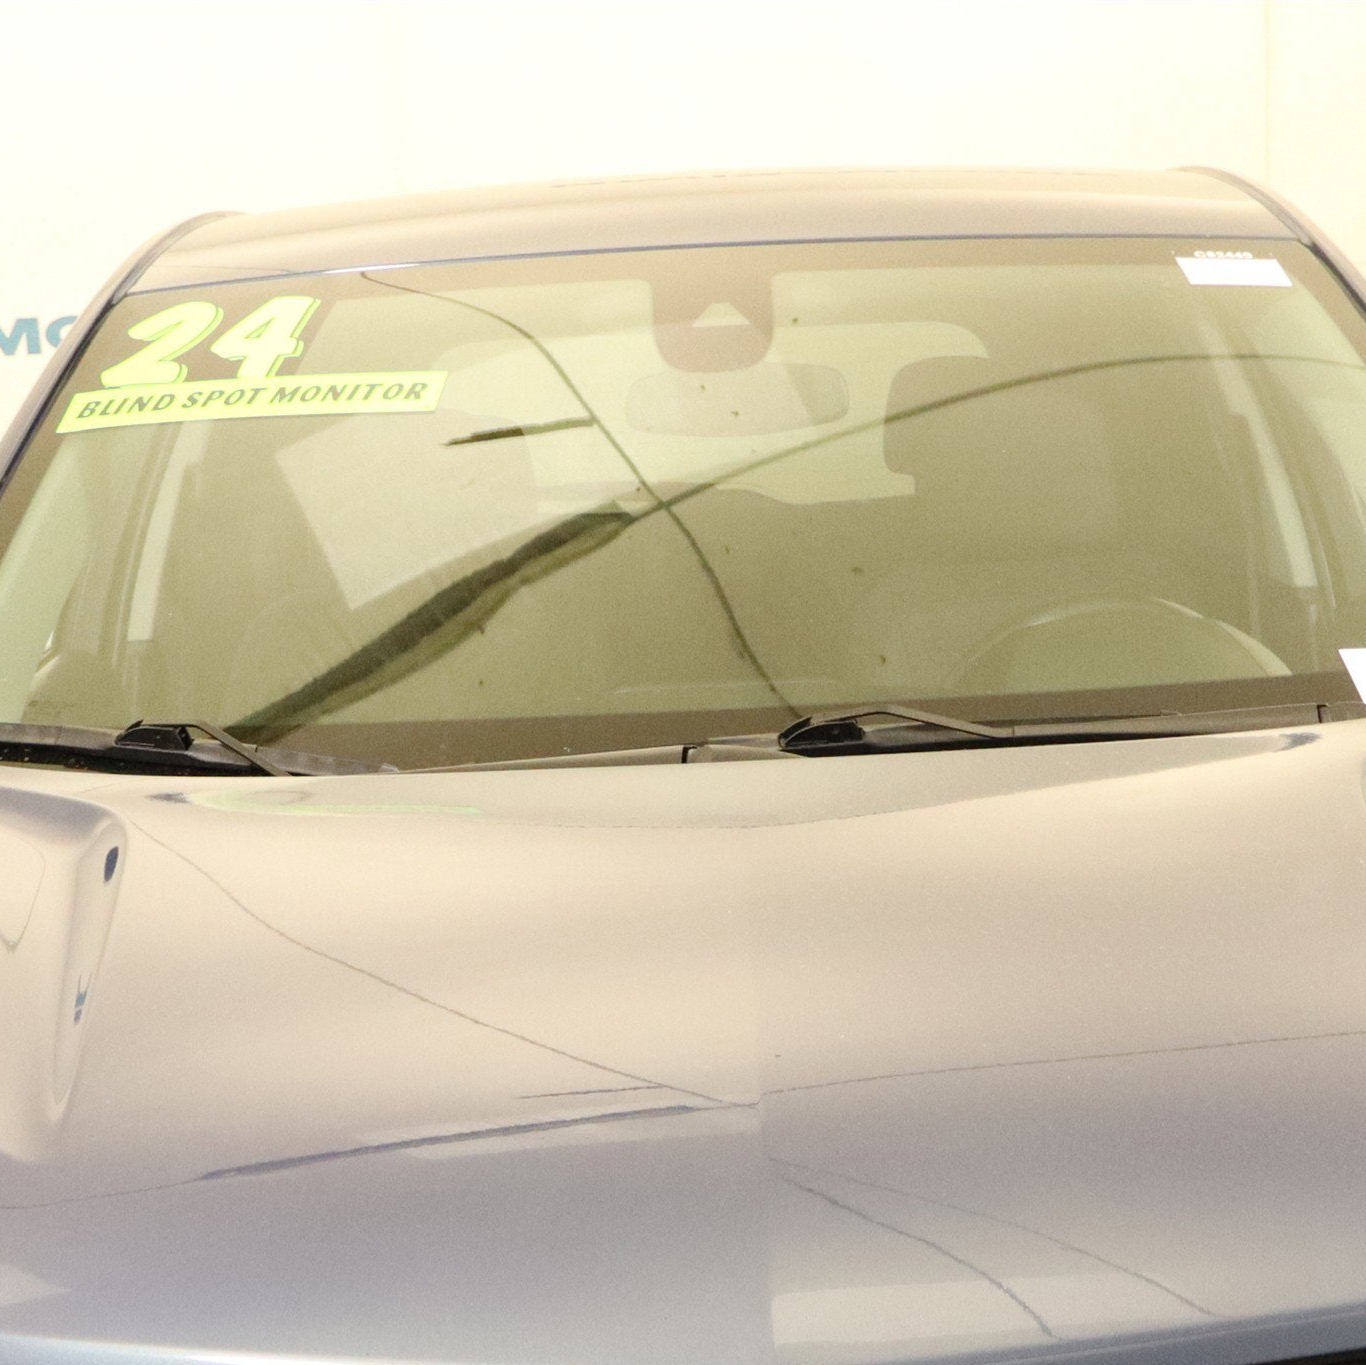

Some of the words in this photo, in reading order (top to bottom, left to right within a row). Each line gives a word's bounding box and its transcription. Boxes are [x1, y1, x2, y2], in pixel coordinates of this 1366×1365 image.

[100, 296, 321, 389] 24
[76, 393, 176, 420] BLIND
[181, 387, 266, 410] SPOT
[269, 381, 429, 404] MONITOR
